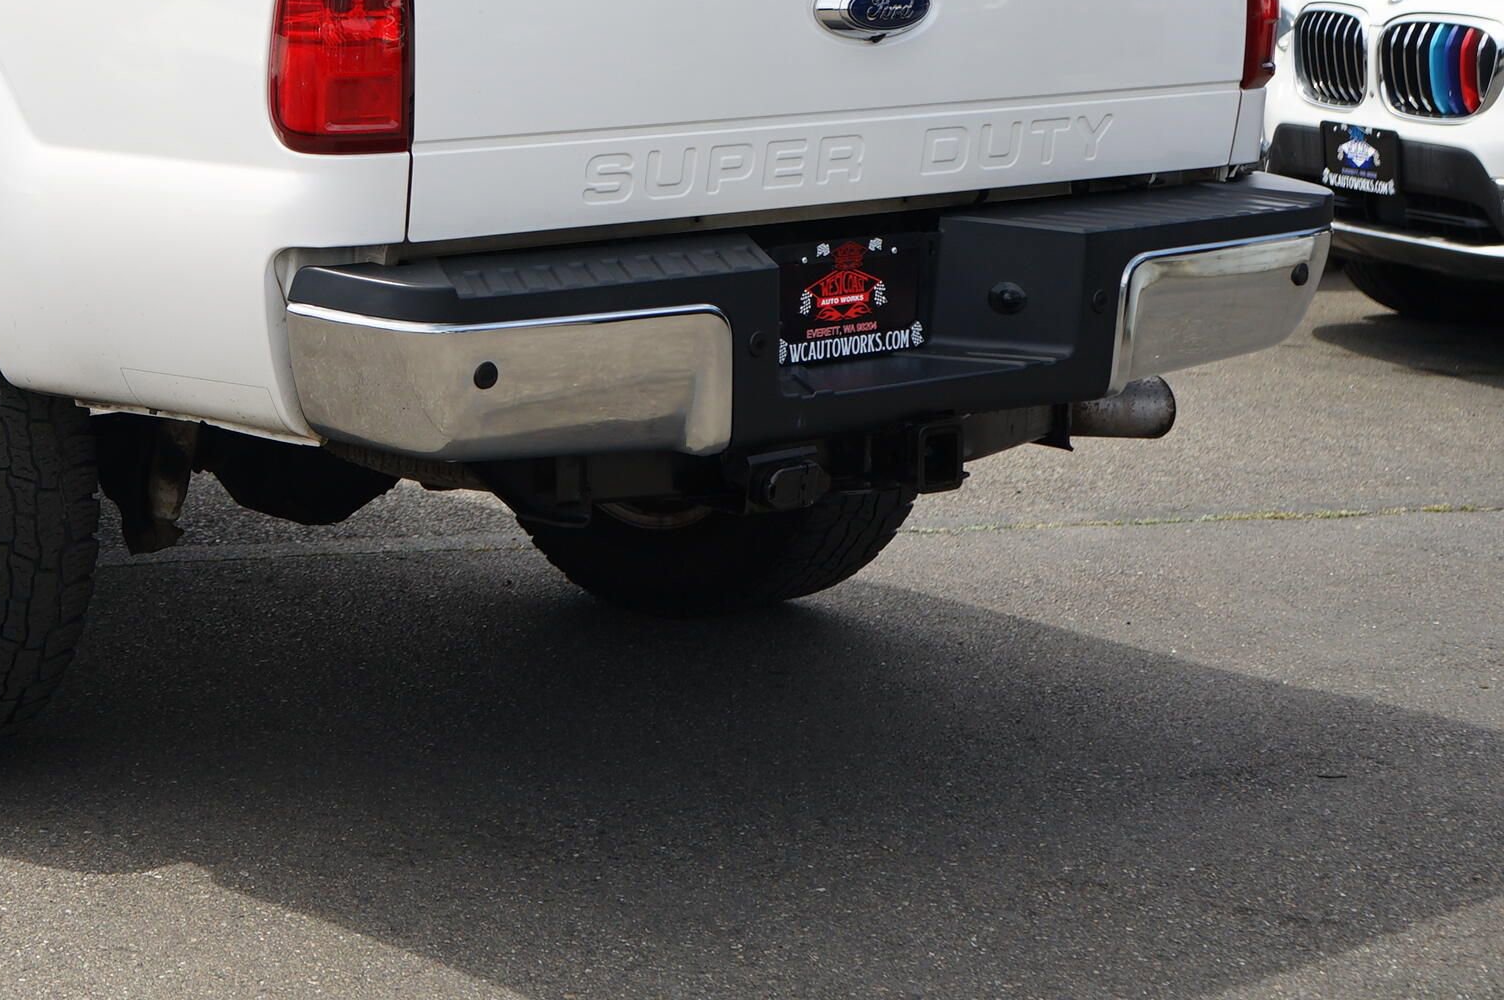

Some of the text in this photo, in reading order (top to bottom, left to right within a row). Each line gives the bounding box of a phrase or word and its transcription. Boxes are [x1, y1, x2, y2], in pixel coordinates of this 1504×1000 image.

[582, 112, 1115, 206] SUPER DUTY
[821, 294, 865, 306] AUTO WORKS
[806, 325, 842, 339] EVERETT,
[842, 322, 856, 334] WA
[789, 328, 911, 363] WCAUTOWORKS.COM
